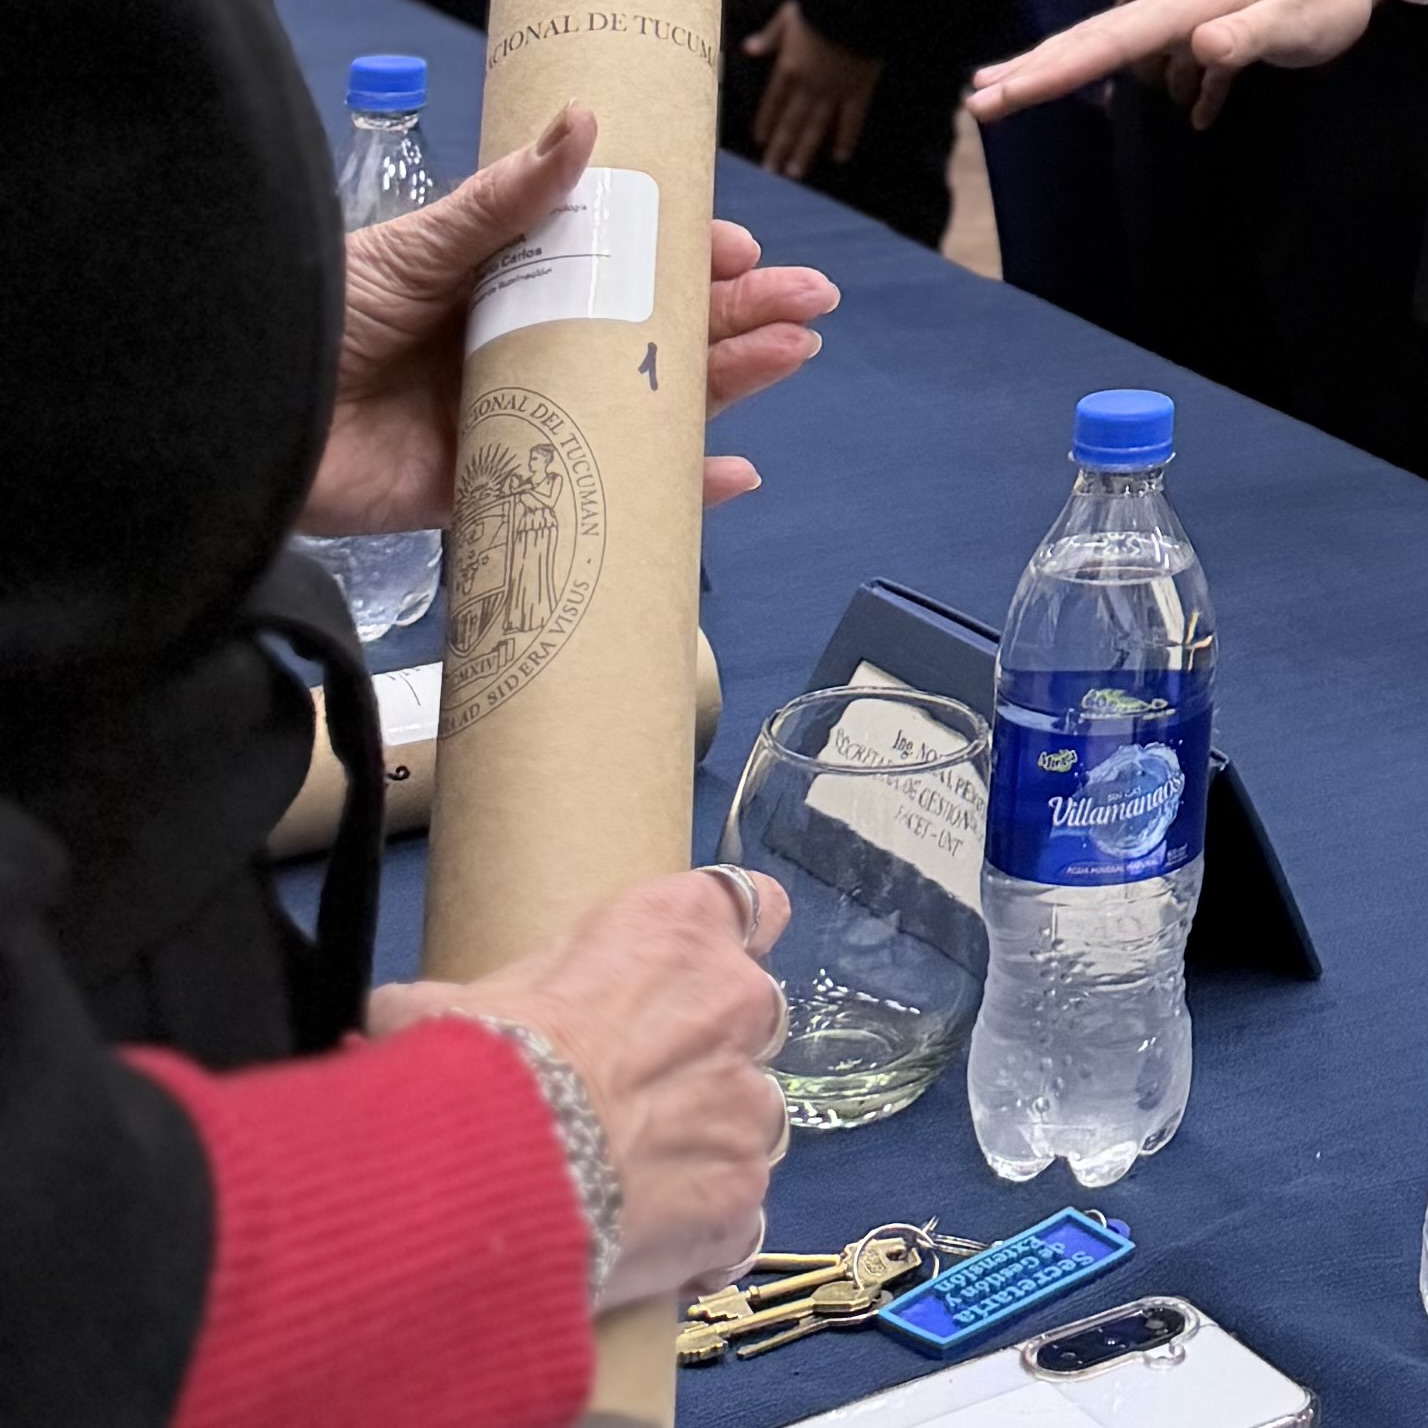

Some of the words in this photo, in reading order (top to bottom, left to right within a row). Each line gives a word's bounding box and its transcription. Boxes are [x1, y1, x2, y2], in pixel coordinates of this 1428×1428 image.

[588, 12, 627, 32] DE
[638, 341, 659, 391] 1
[529, 403, 566, 436] DEL
[560, 432, 600, 537] TUCUMAN
[487, 641, 556, 706] SIDERA
[548, 579, 590, 635] VISUS
[1048, 773, 1186, 827] Villamanaos
